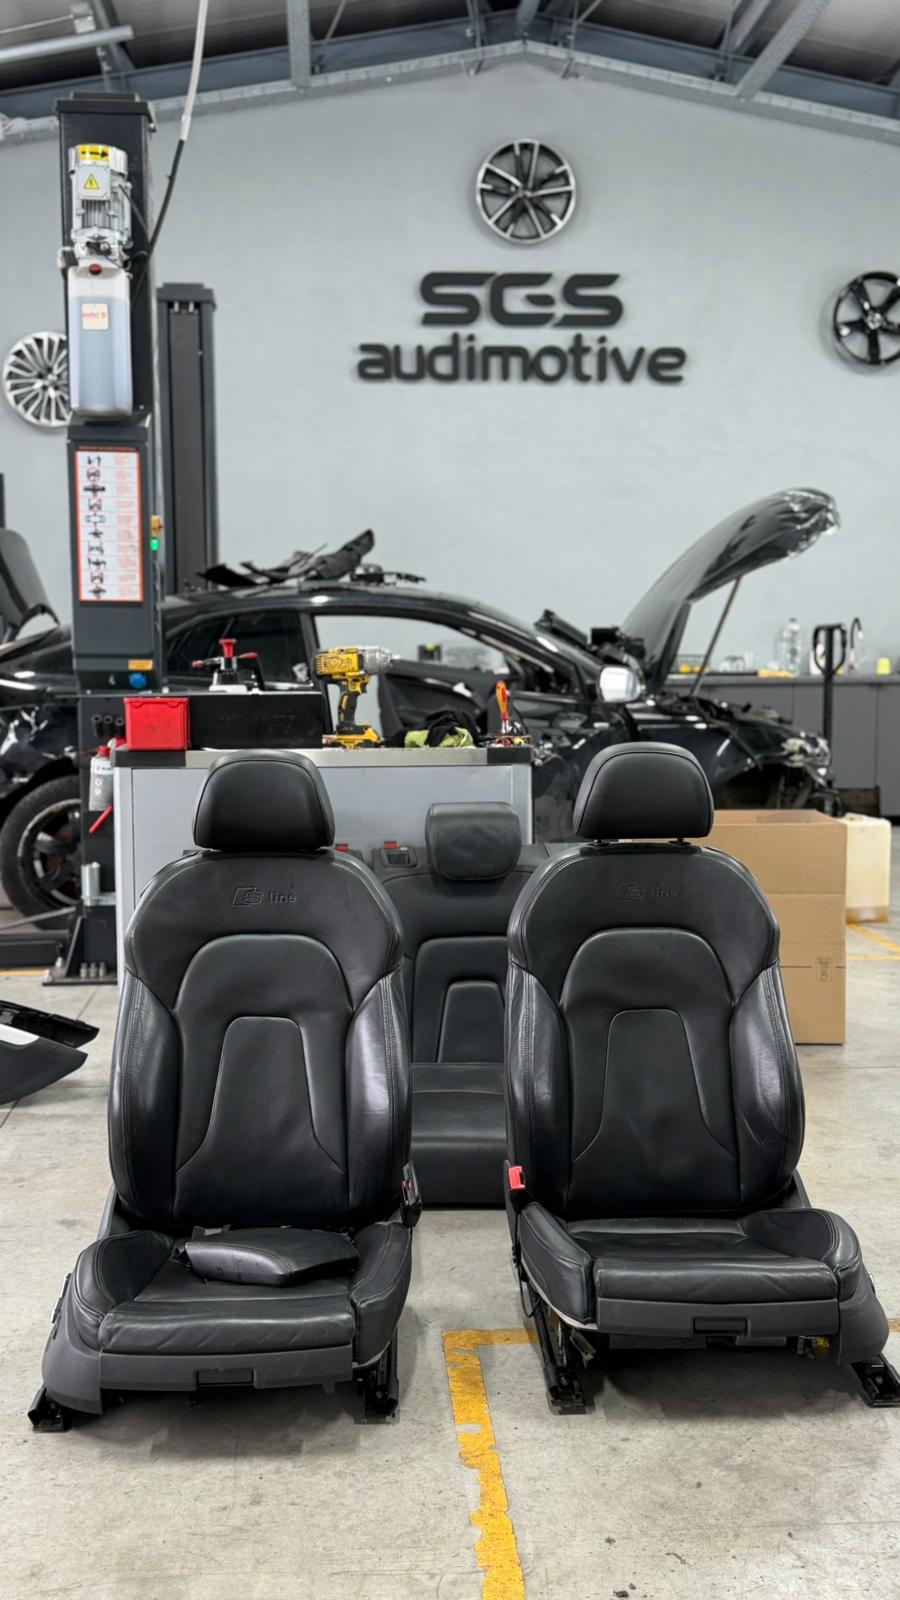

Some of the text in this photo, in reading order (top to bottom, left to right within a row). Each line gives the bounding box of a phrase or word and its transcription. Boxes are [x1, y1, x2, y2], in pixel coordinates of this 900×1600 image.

[419, 271, 624, 328] SGS
[356, 332, 688, 385] audimotive
[268, 890, 297, 904] line
